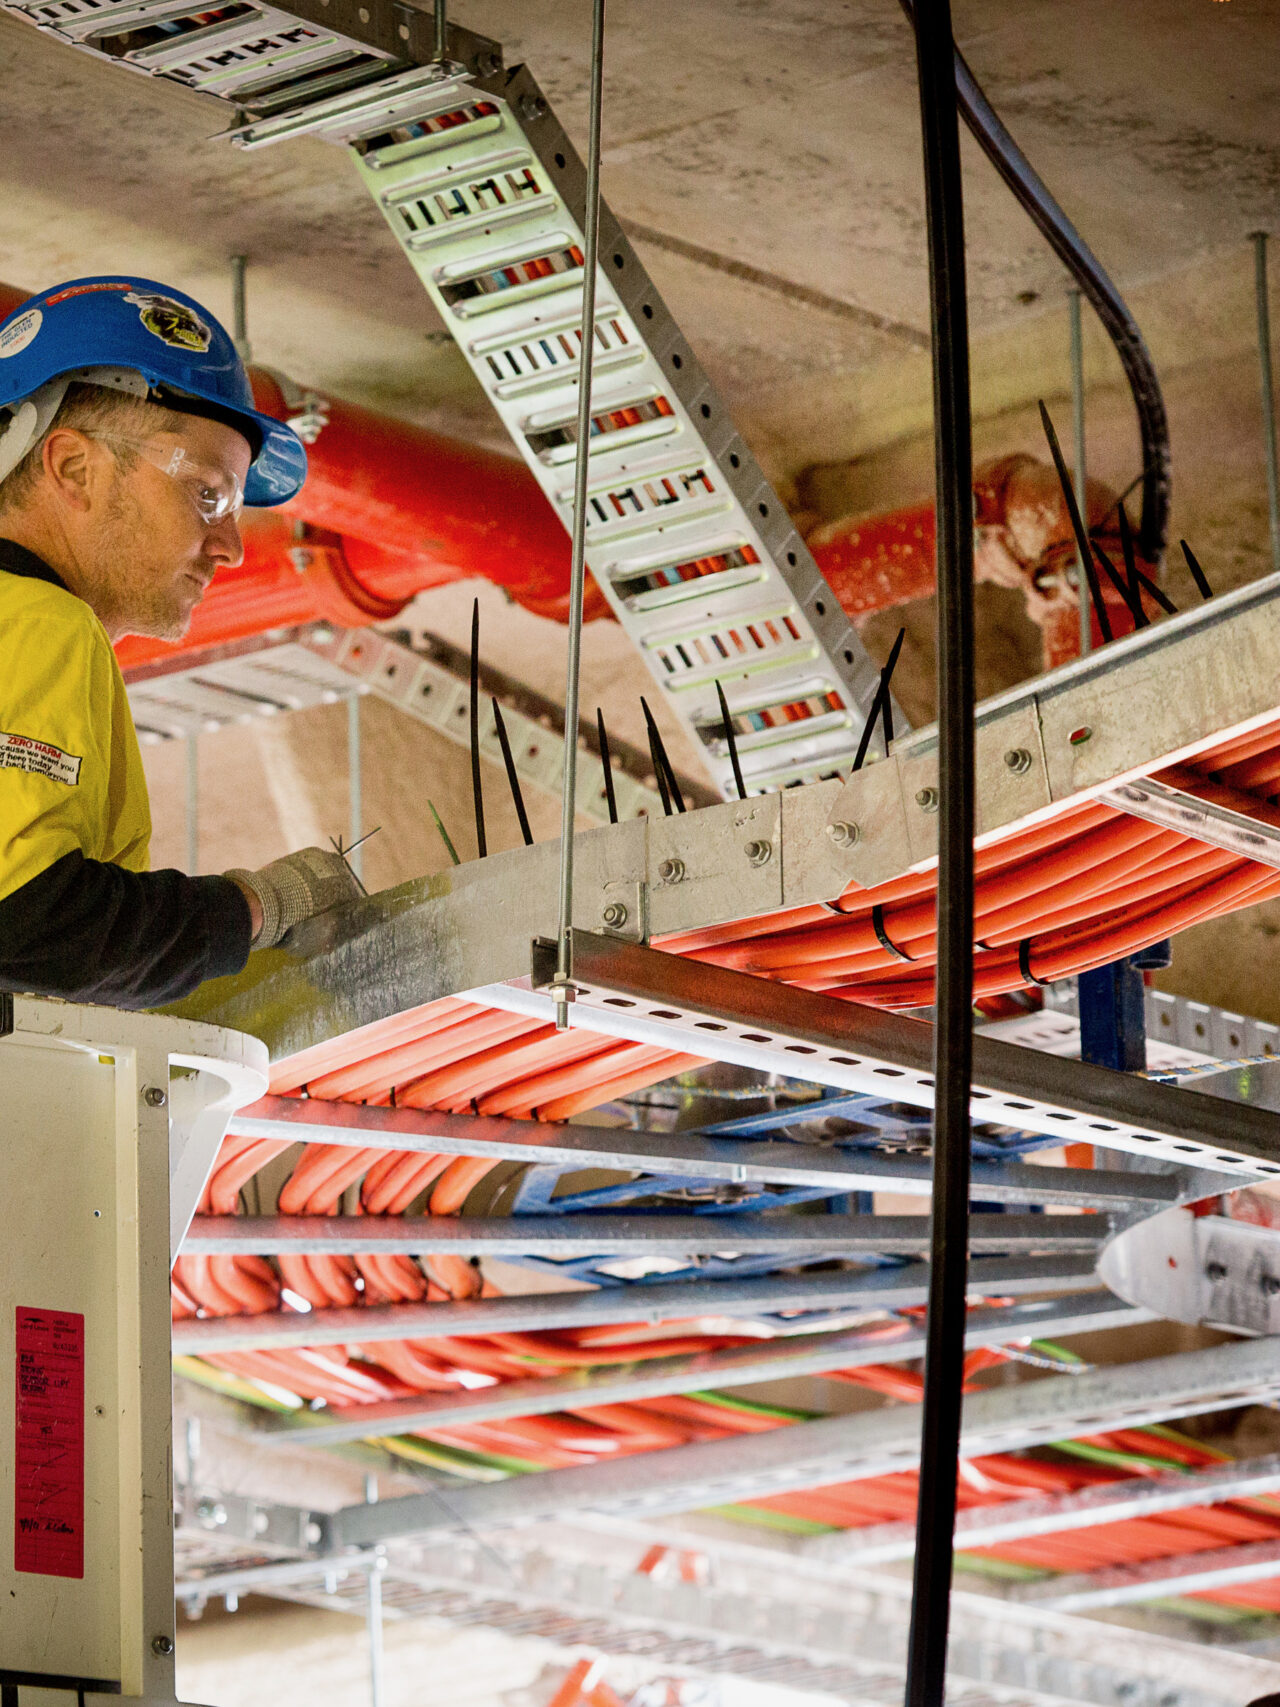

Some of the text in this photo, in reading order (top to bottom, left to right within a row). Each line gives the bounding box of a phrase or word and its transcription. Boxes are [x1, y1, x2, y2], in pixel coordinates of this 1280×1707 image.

[8, 736, 62, 759] ZERO HARM
[6, 760, 26, 770] back
[7, 753, 52, 771] here today
[41, 754, 59, 766] want
[60, 764, 74, 772] you
